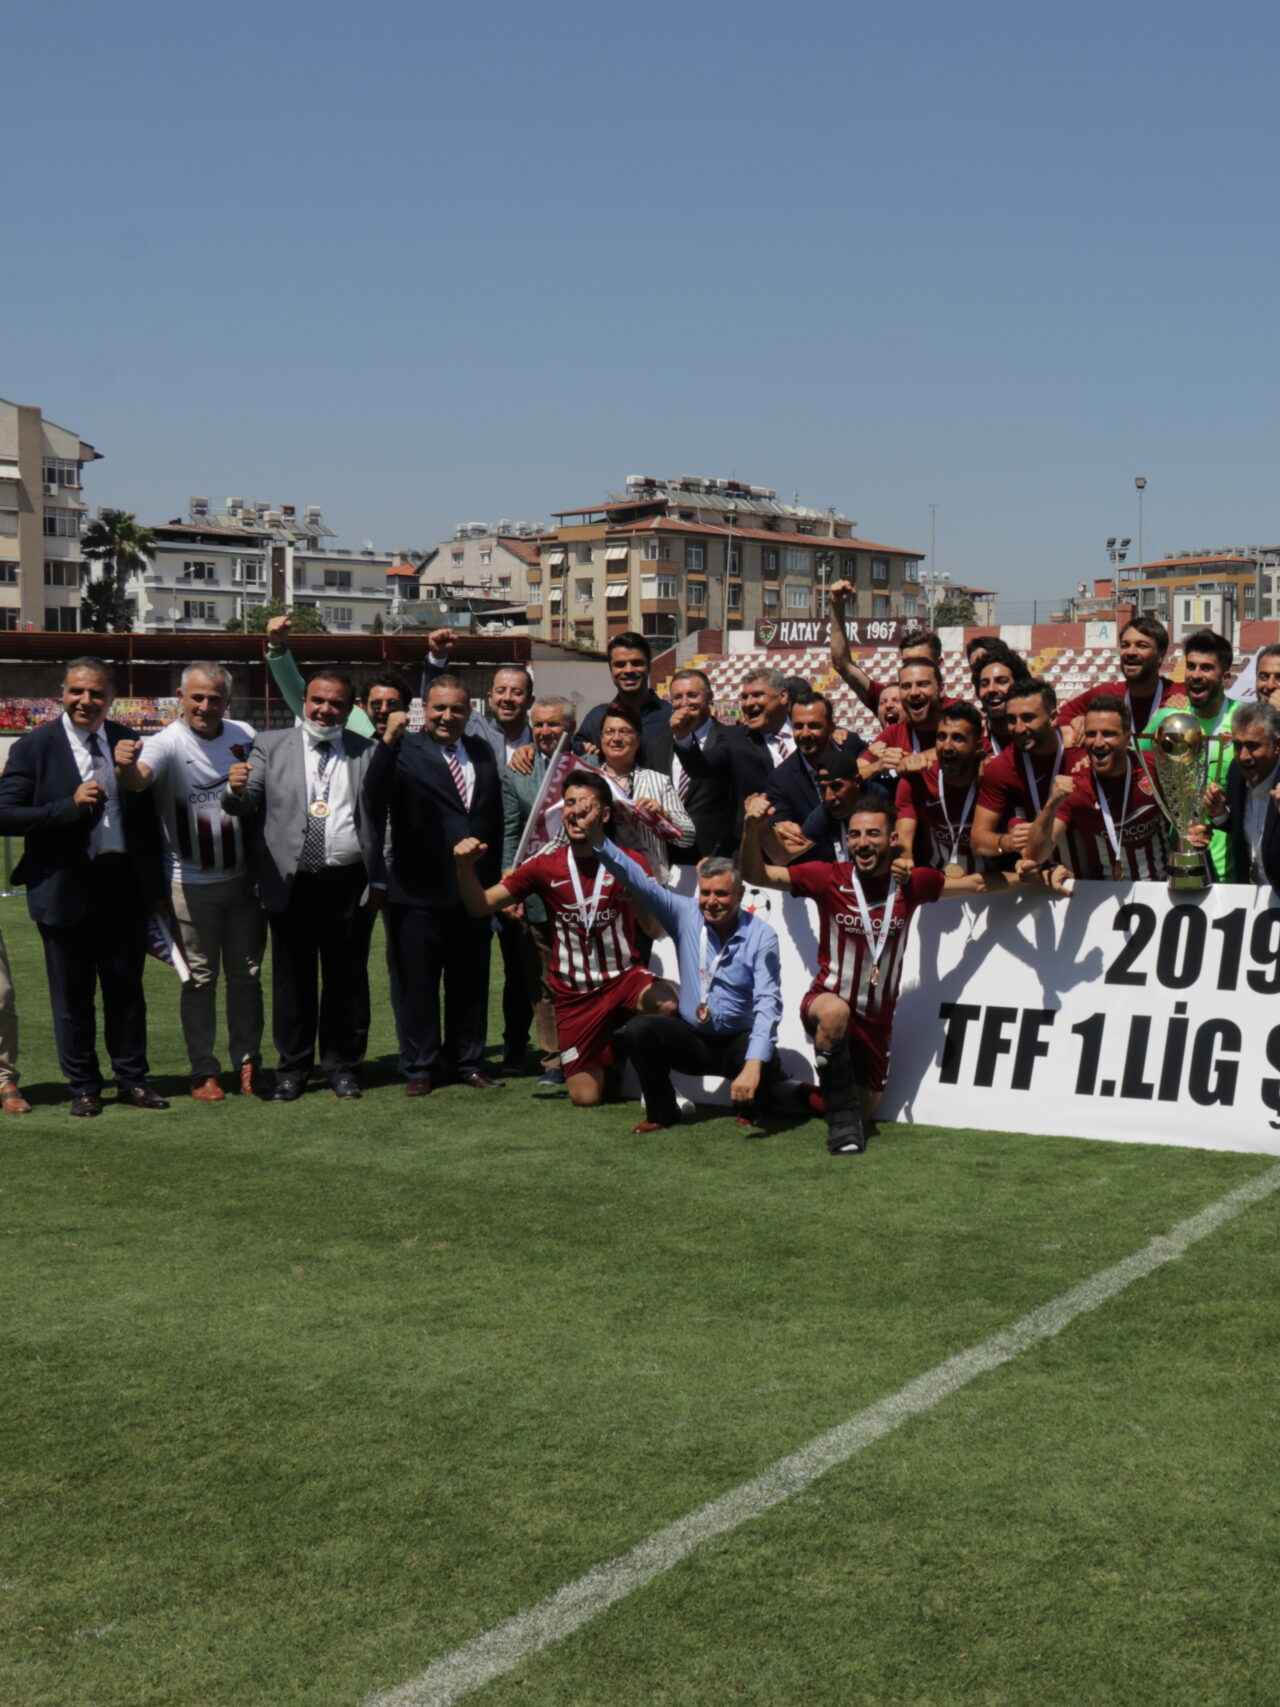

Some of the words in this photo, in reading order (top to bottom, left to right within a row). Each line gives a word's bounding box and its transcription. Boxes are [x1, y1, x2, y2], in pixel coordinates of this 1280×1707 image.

[780, 621, 821, 645] HATAY
[866, 621, 897, 641] 1967
[937, 1001, 1058, 1092] TFF
[1071, 1001, 1242, 1107] 1.LİG
